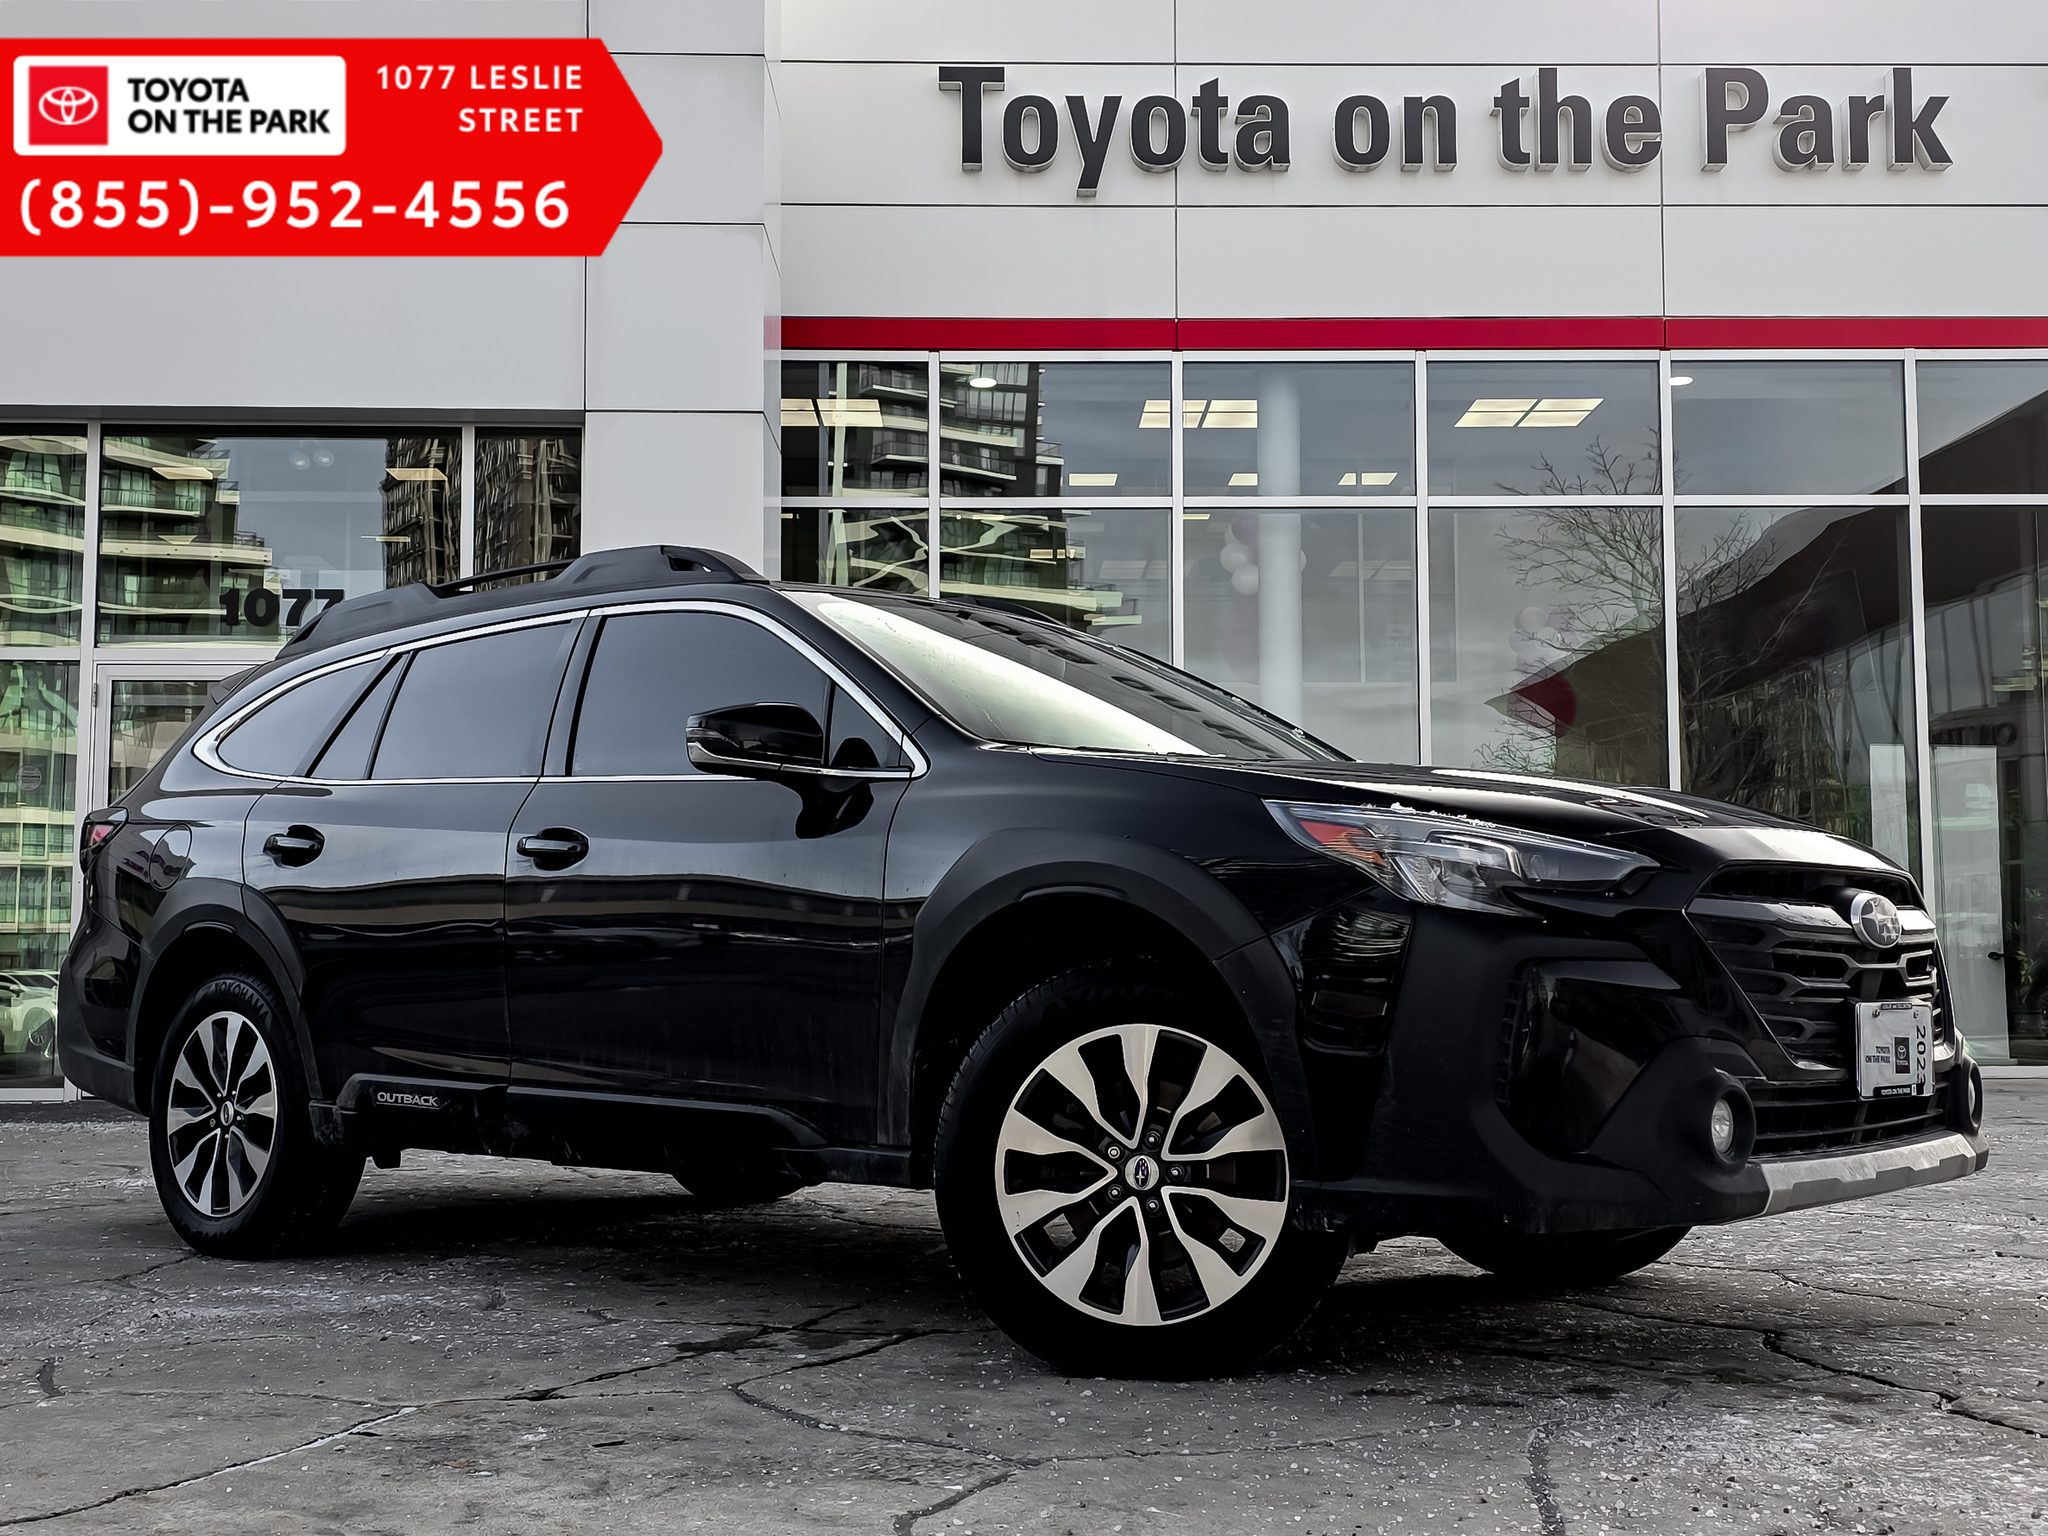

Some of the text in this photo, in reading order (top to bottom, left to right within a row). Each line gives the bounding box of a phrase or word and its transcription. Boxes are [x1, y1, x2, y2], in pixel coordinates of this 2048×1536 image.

[938, 66, 1953, 197] Toyota on the Park
[220, 588, 345, 627] 1077
[214, 981, 269, 1025] YOKOHAMA
[376, 1091, 440, 1107] OUTBACK
